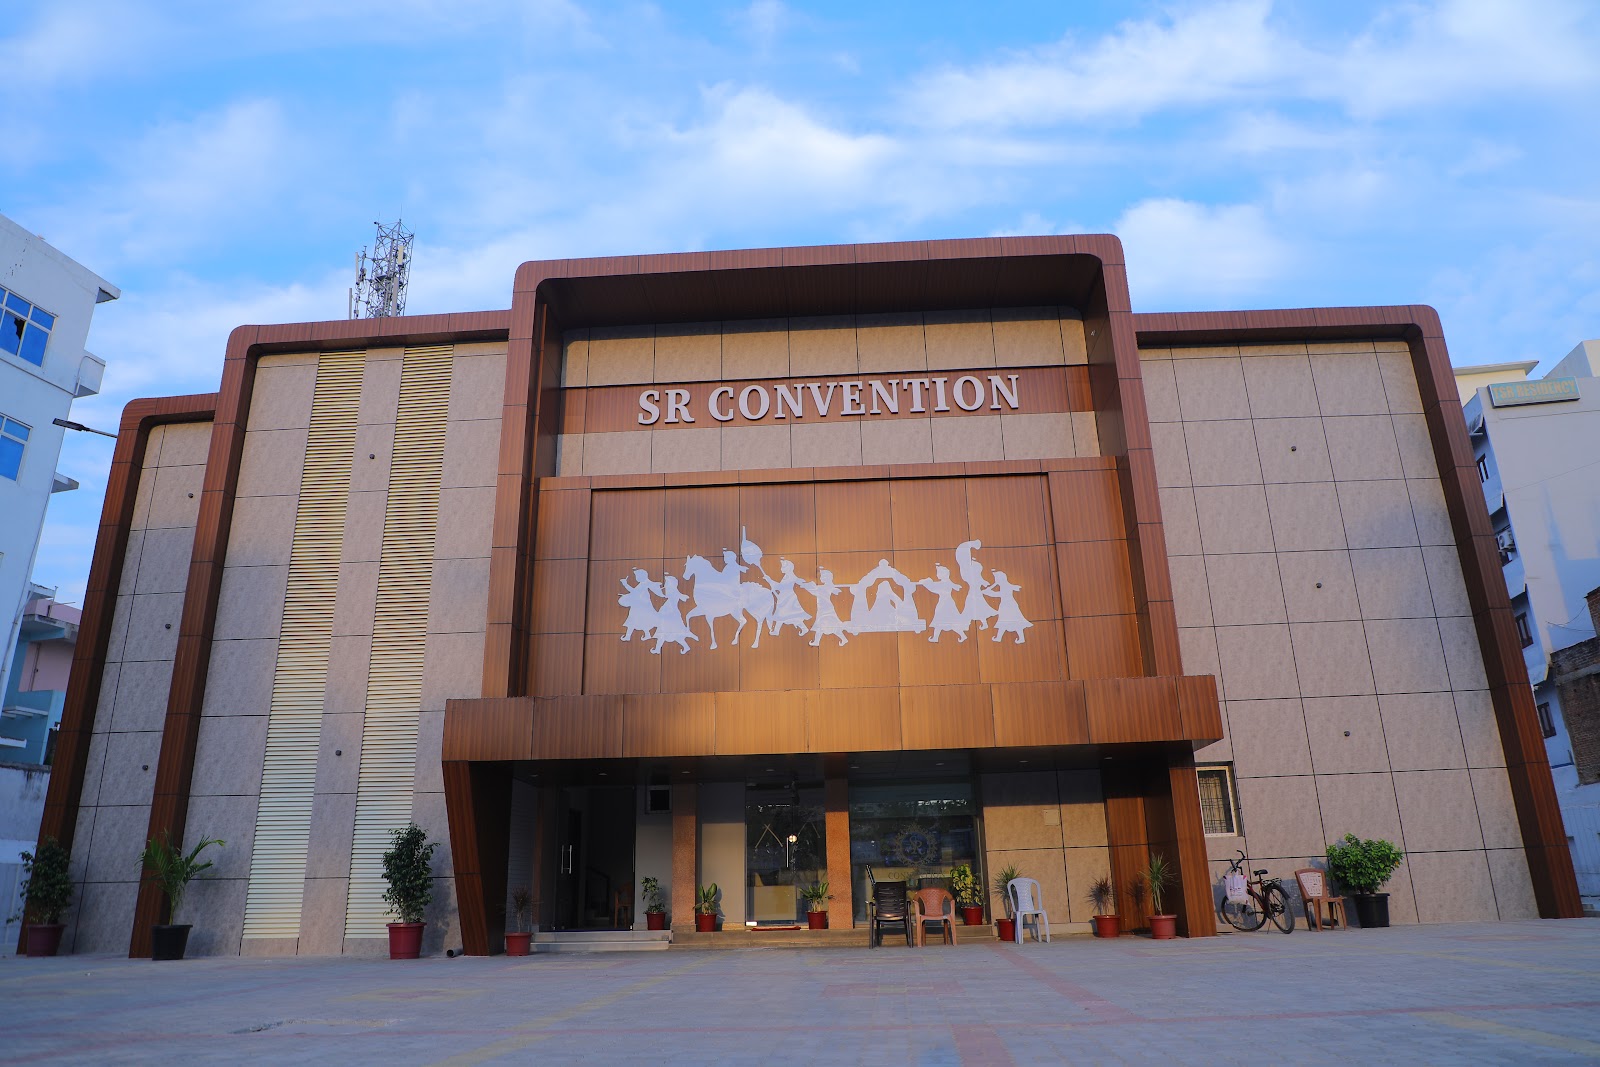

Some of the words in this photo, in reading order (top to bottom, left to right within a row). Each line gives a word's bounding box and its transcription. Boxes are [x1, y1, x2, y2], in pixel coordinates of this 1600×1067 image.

[637, 388, 696, 425] SR
[707, 374, 1020, 422] CONVENTION
[1493, 387, 1514, 399] TSR
[1516, 380, 1576, 397] RESIDENCY
